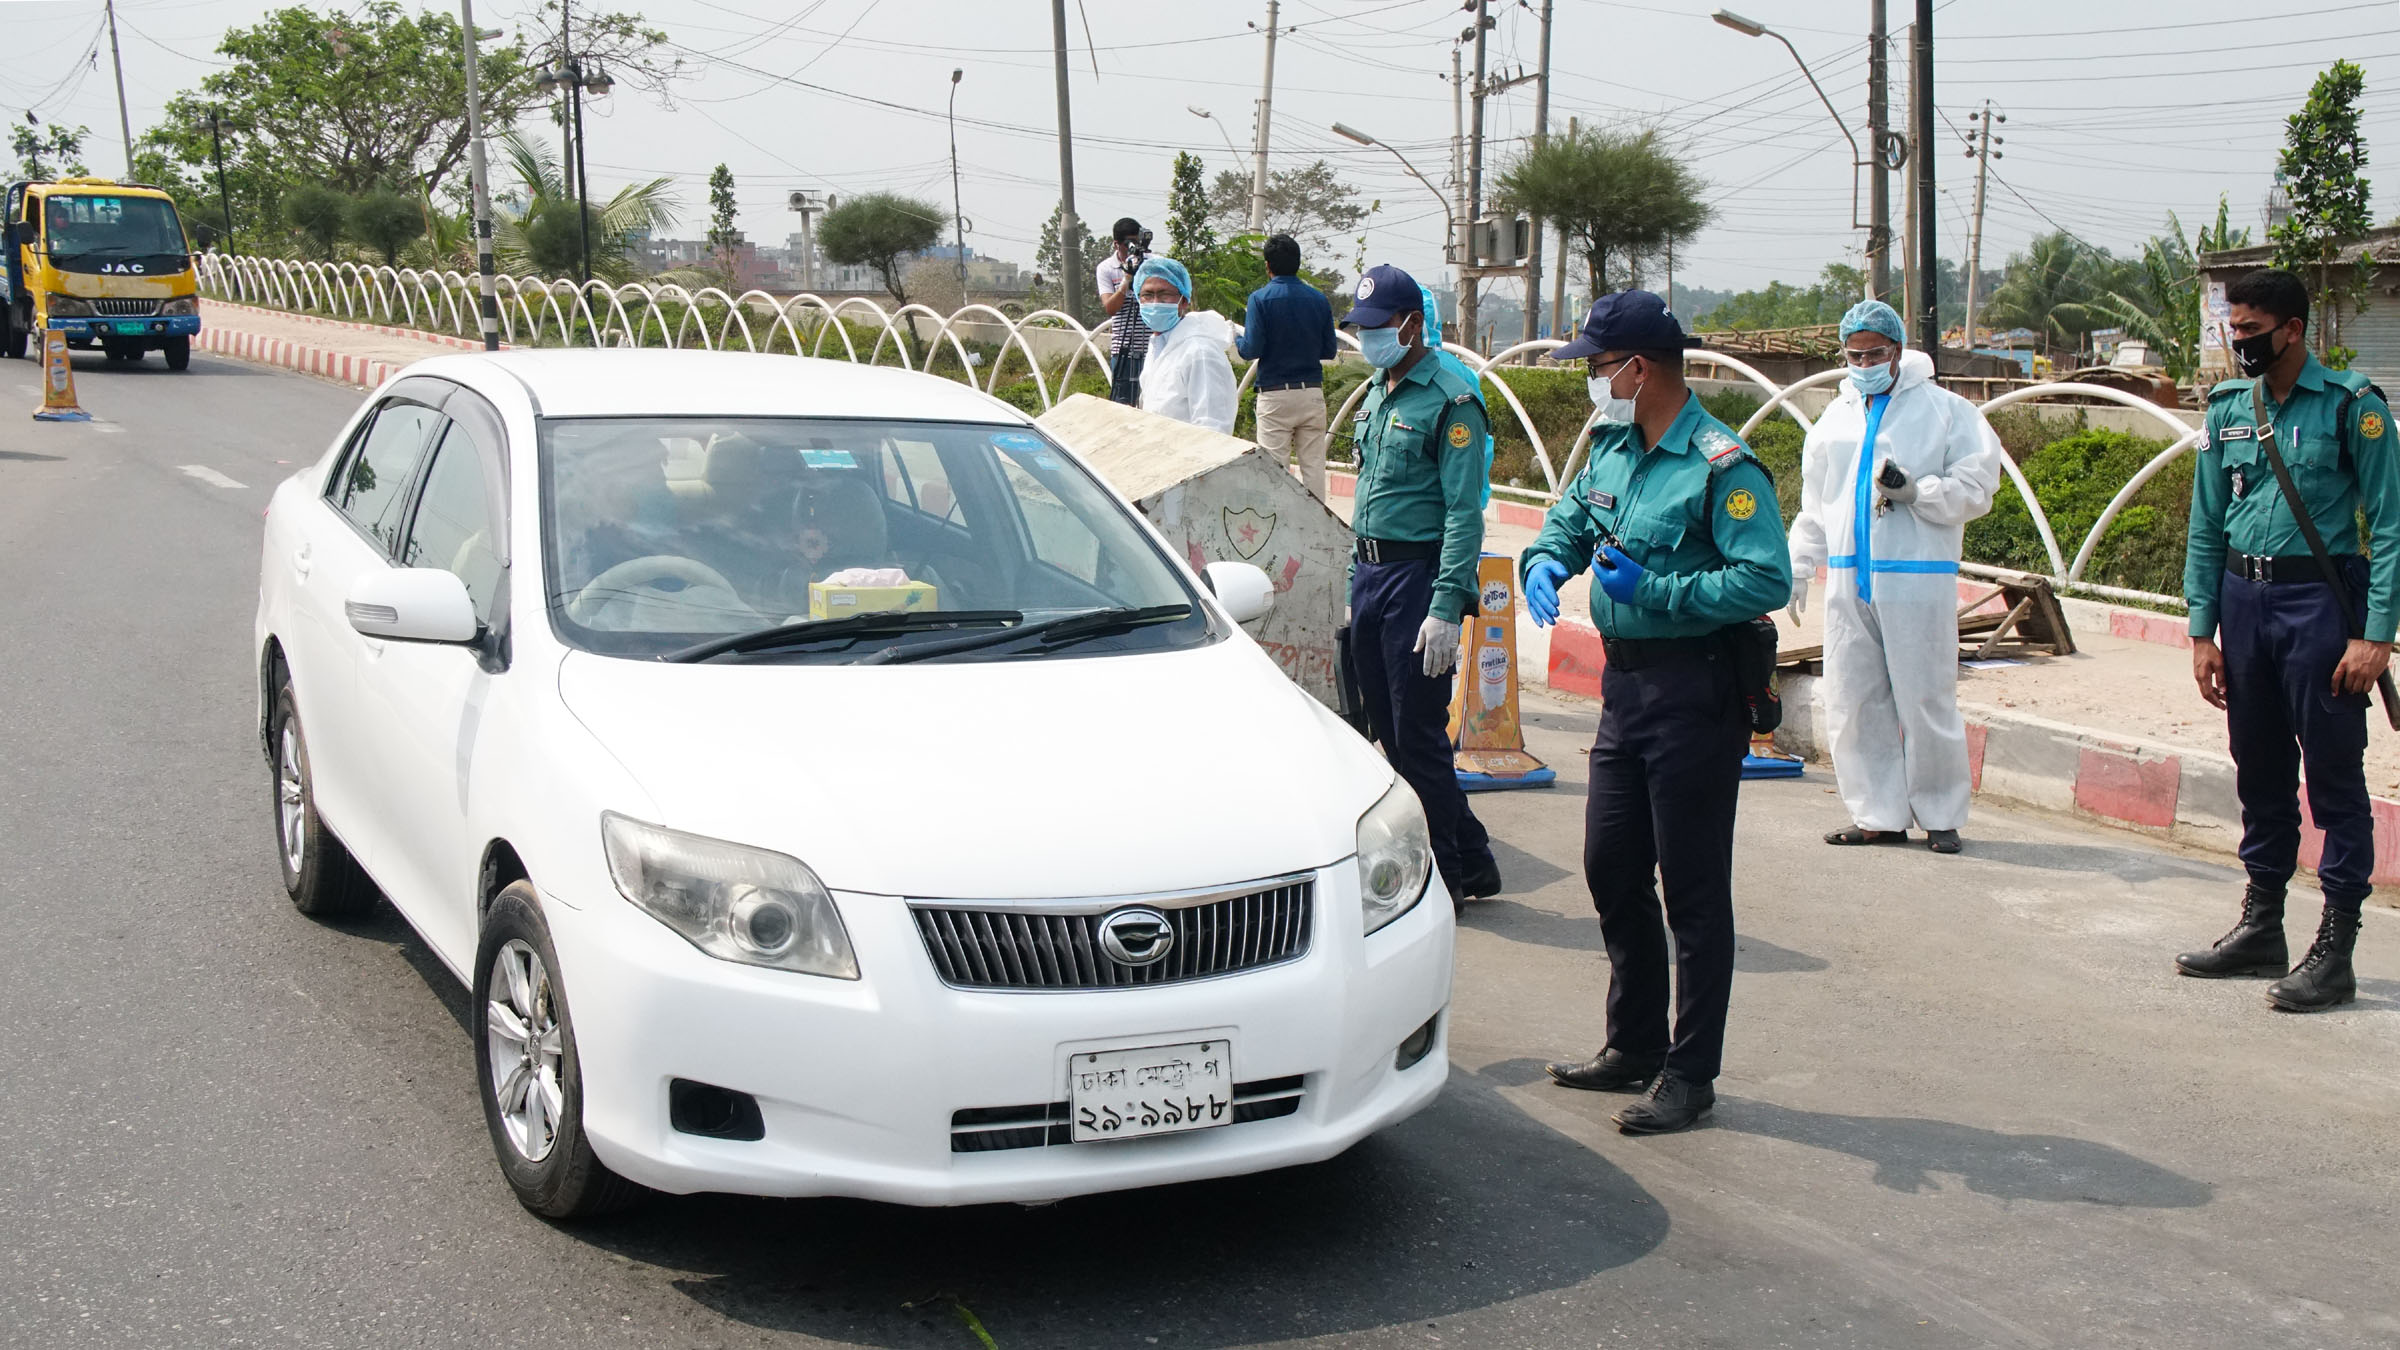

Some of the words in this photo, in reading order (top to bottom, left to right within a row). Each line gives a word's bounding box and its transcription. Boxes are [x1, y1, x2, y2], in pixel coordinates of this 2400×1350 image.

[101, 263, 145, 274] JAC
[1481, 656, 1507, 669] Frutika
[1079, 1094, 1228, 1132] ২৯-৯৯৮৮
